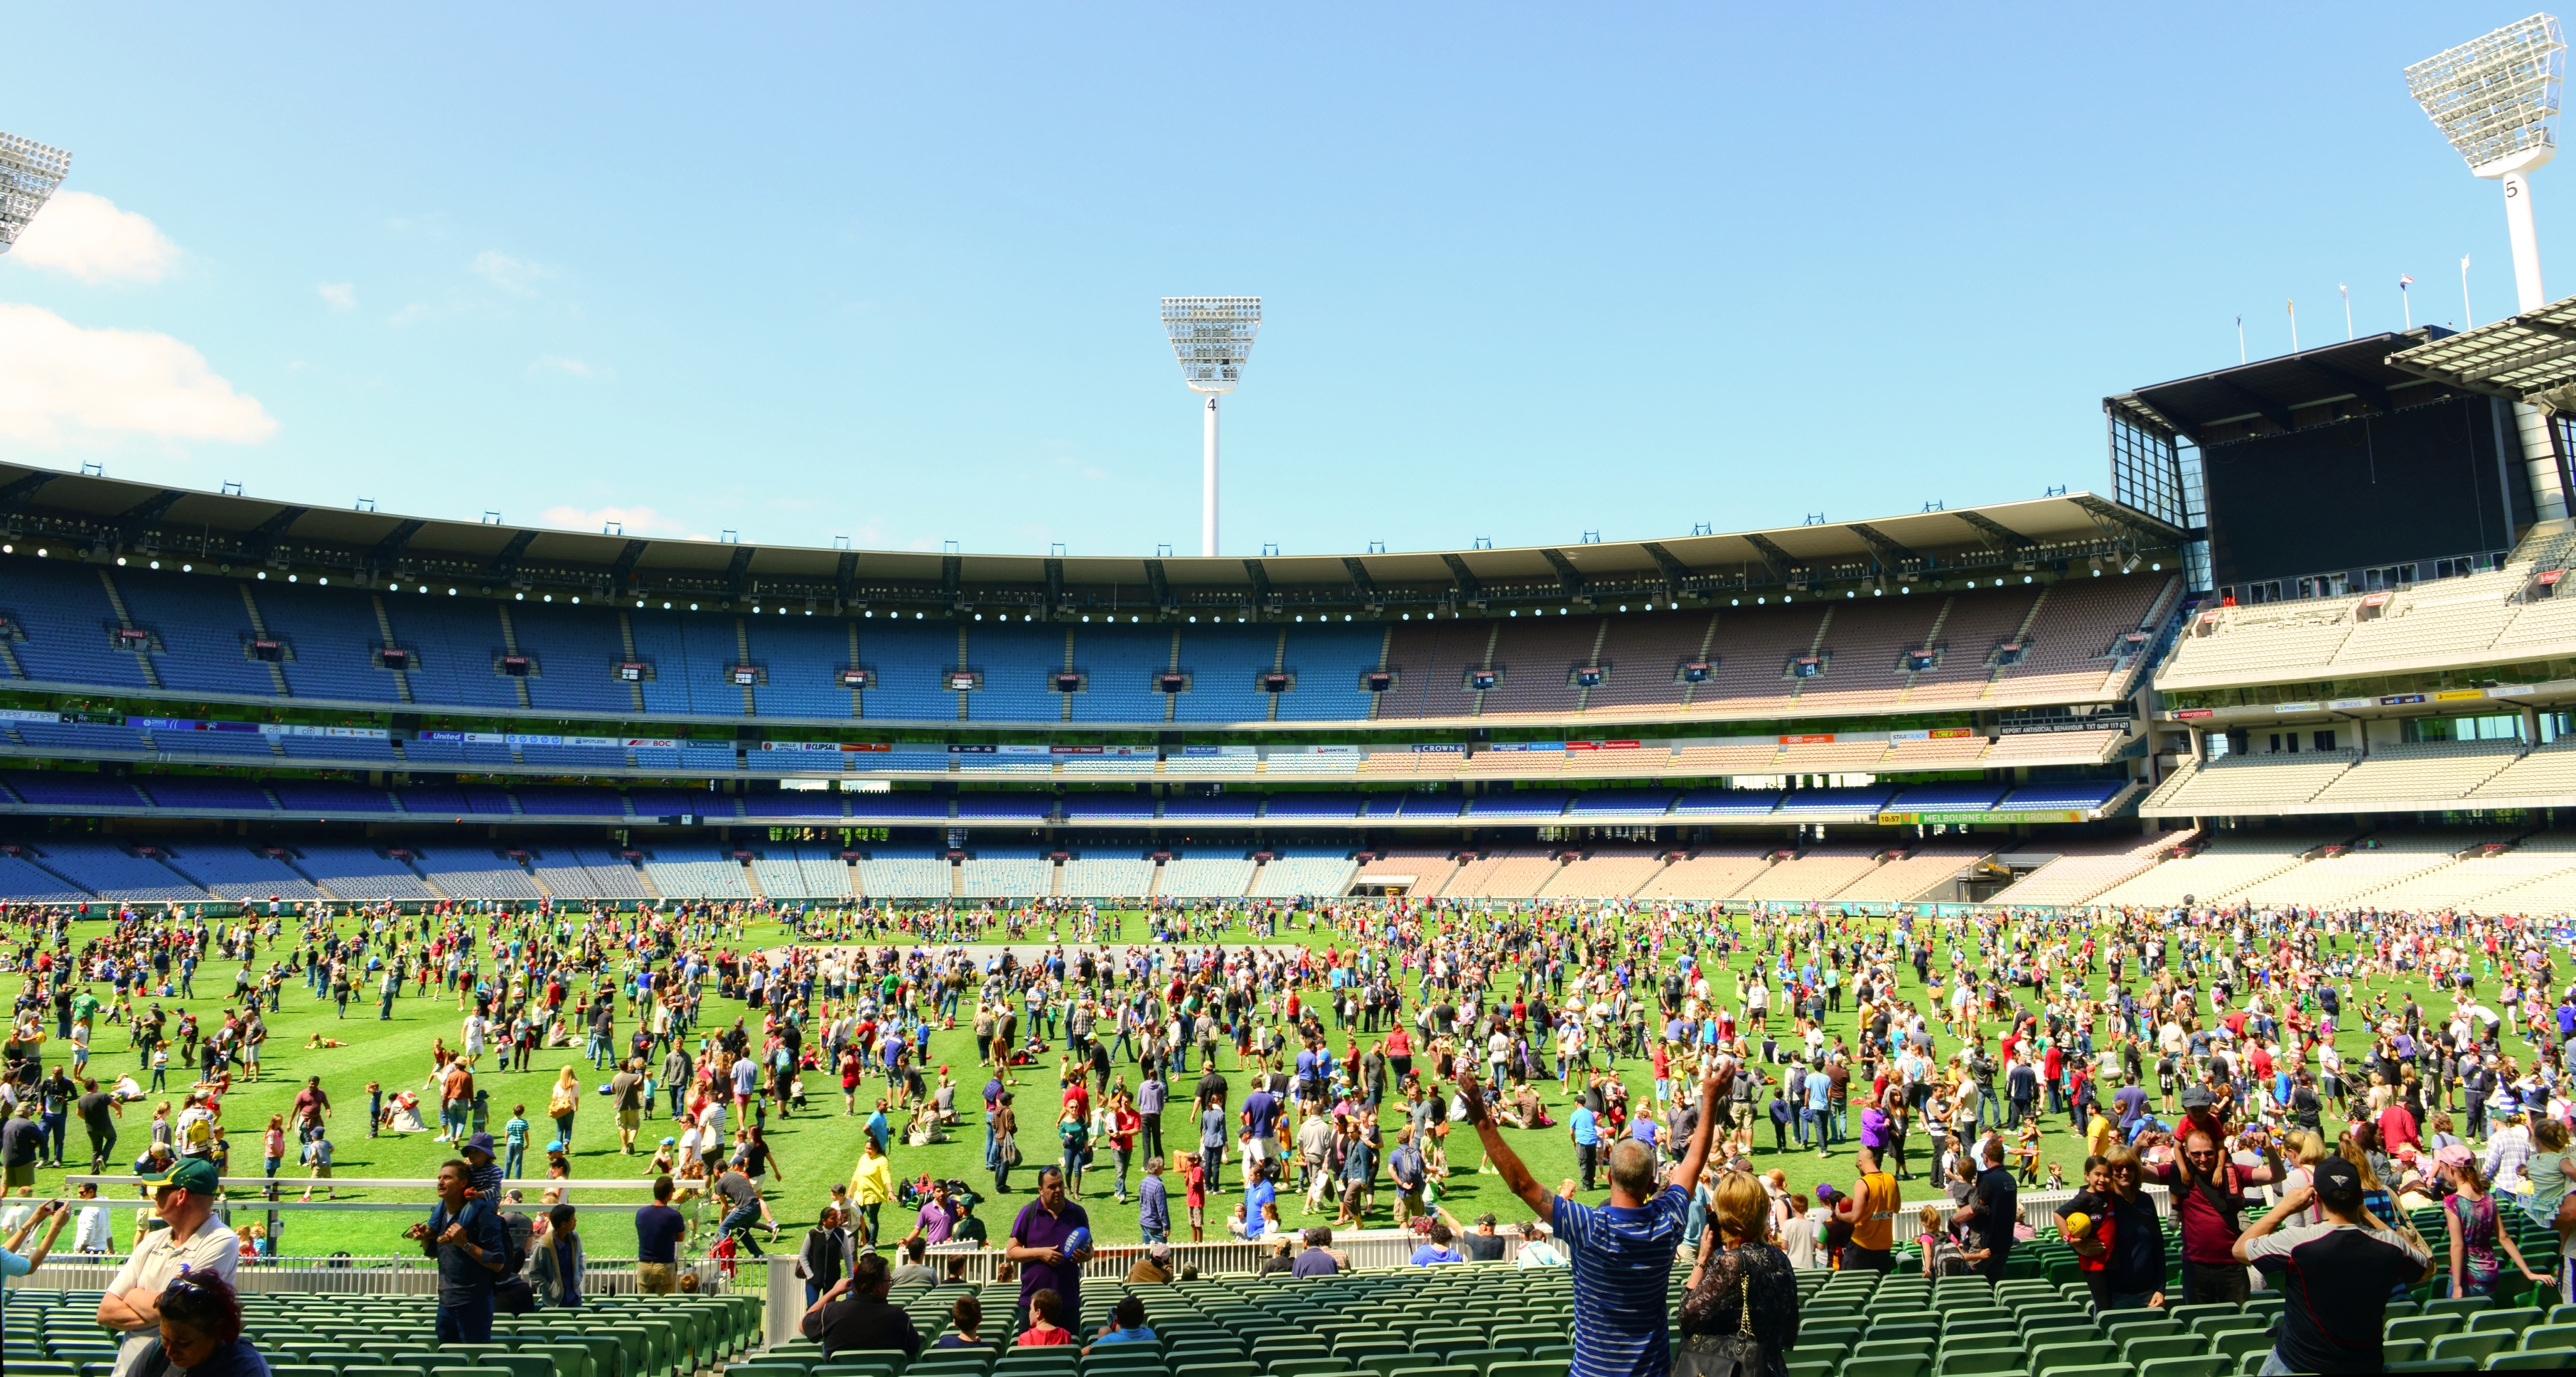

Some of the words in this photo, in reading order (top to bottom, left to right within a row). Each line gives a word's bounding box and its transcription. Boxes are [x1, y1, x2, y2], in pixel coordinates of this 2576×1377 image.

[2506, 181, 2518, 198] 5
[1207, 399, 1216, 411] 4
[1924, 814, 1981, 823] MELBOURNE
[1982, 813, 2022, 822] CRICKET
[2024, 813, 2063, 821] GROUND
[1064, 1230, 1080, 1253] SIMS
